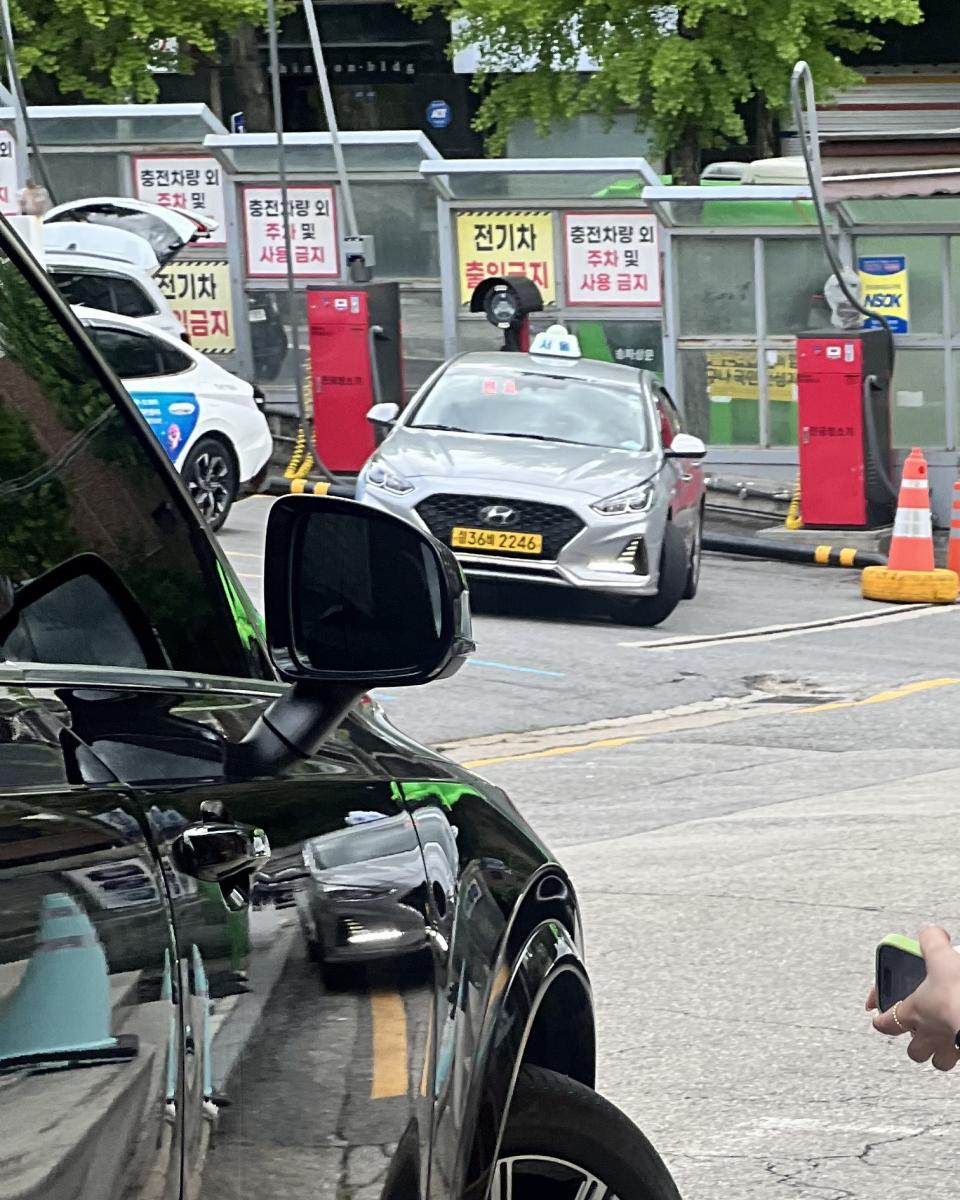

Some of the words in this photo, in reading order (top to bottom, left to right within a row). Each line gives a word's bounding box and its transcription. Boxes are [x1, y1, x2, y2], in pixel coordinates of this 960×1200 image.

[141, 169, 200, 187] 충전차량
[205, 169, 220, 187] 외
[157, 193, 187, 209] 주차
[192, 193, 206, 209] 및
[249, 200, 310, 217] 충전차량
[315, 200, 329, 217] 외
[302, 223, 316, 240] 및
[474, 223, 537, 252] 전기차
[570, 226, 633, 244] 충전차량
[638, 226, 655, 244] 외
[260, 246, 288, 263] 사용
[295, 246, 325, 263] 금지
[587, 250, 619, 268] 주차
[624, 250, 640, 268] 및
[158, 273, 217, 300] 전기차
[580, 273, 612, 291] 사용
[617, 273, 649, 291] 금지
[864, 293, 904, 308] NSOK
[499, 534, 536, 550] 2246
